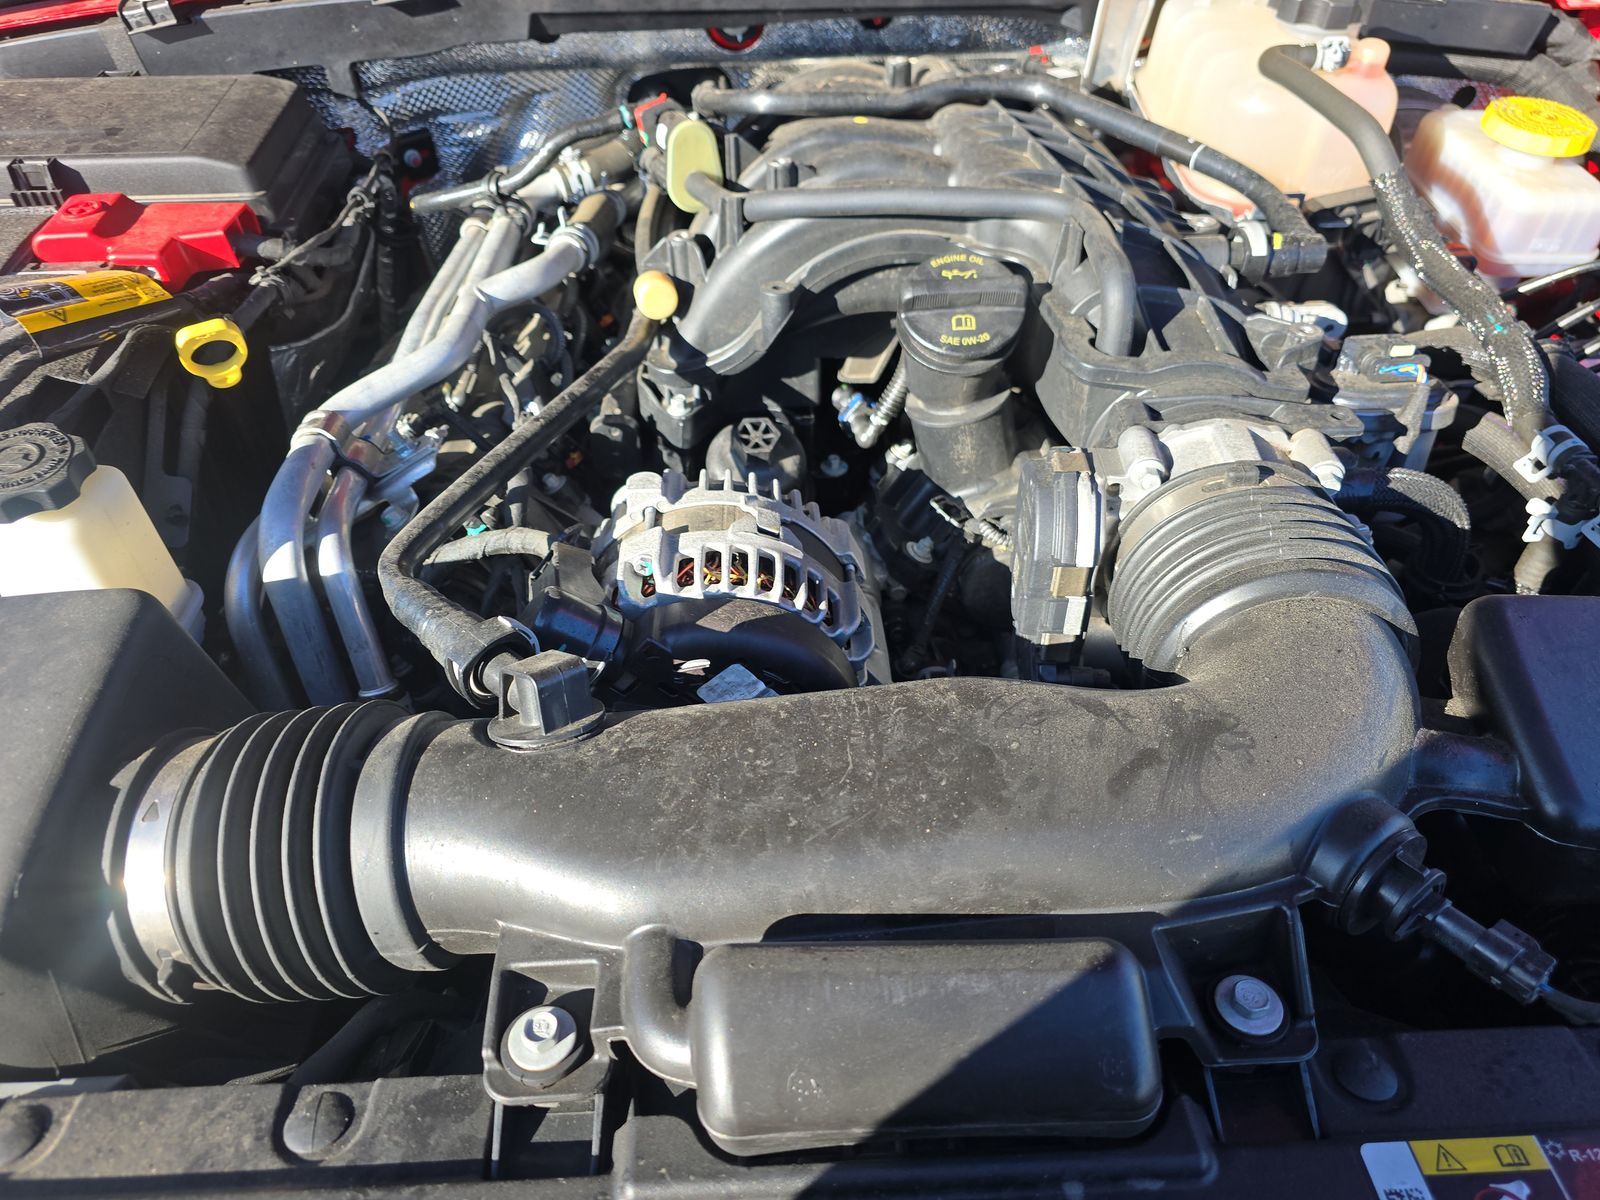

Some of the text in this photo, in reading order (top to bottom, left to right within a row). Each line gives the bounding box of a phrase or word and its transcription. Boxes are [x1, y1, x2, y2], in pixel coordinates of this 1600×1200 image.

[930, 254, 985, 268] ENGINE OIL
[939, 332, 991, 346] SAE 0W-20
